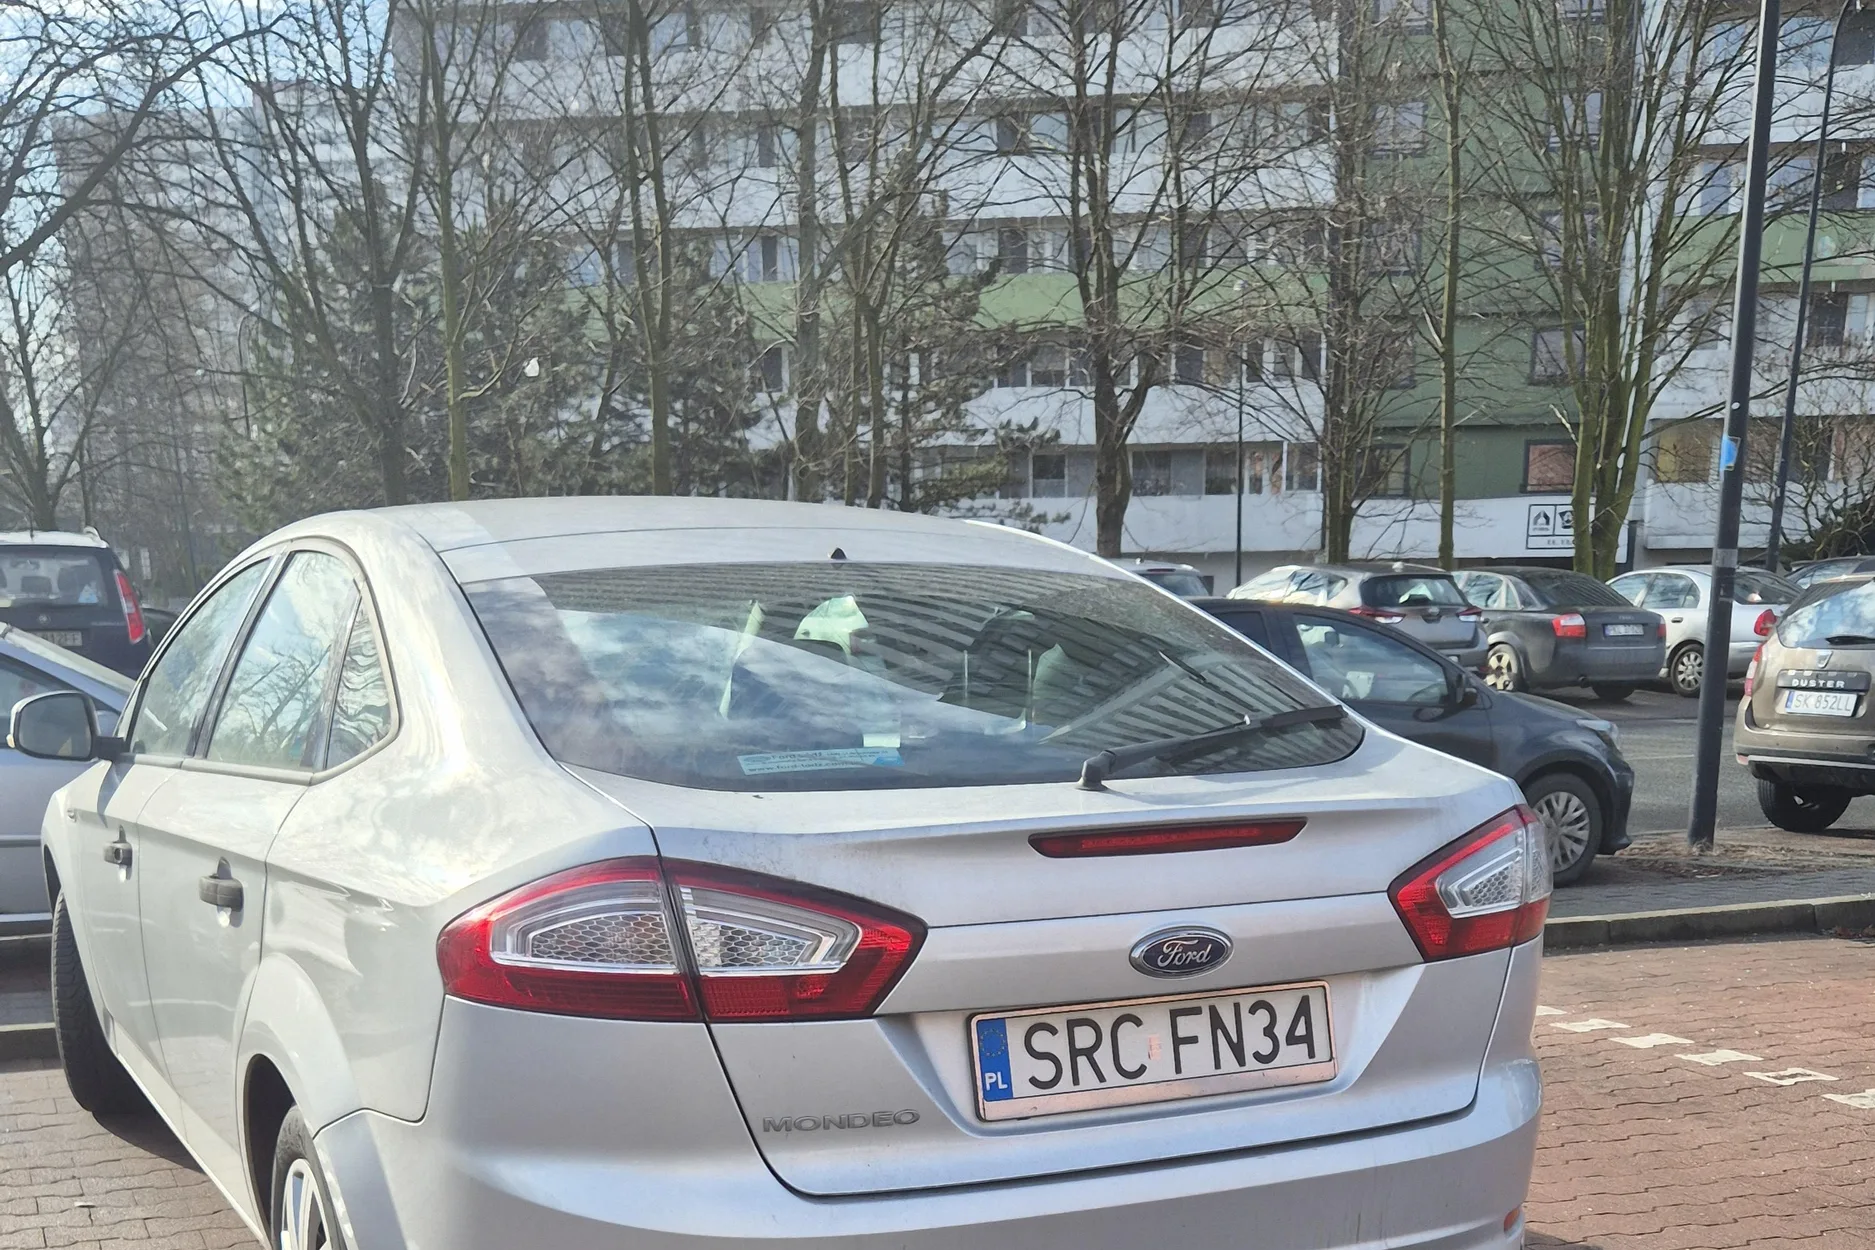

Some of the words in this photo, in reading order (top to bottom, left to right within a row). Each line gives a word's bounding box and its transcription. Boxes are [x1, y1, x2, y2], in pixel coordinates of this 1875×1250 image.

[1791, 679, 1845, 689] DUSTER
[1794, 694, 1811, 709] SK
[1814, 695, 1851, 712] 852LL
[1157, 939, 1212, 968] Ford
[1023, 1013, 1148, 1090] SRC
[1169, 994, 1316, 1075] FN34
[984, 1071, 1009, 1091] PL
[763, 1108, 921, 1132] MONDEO
